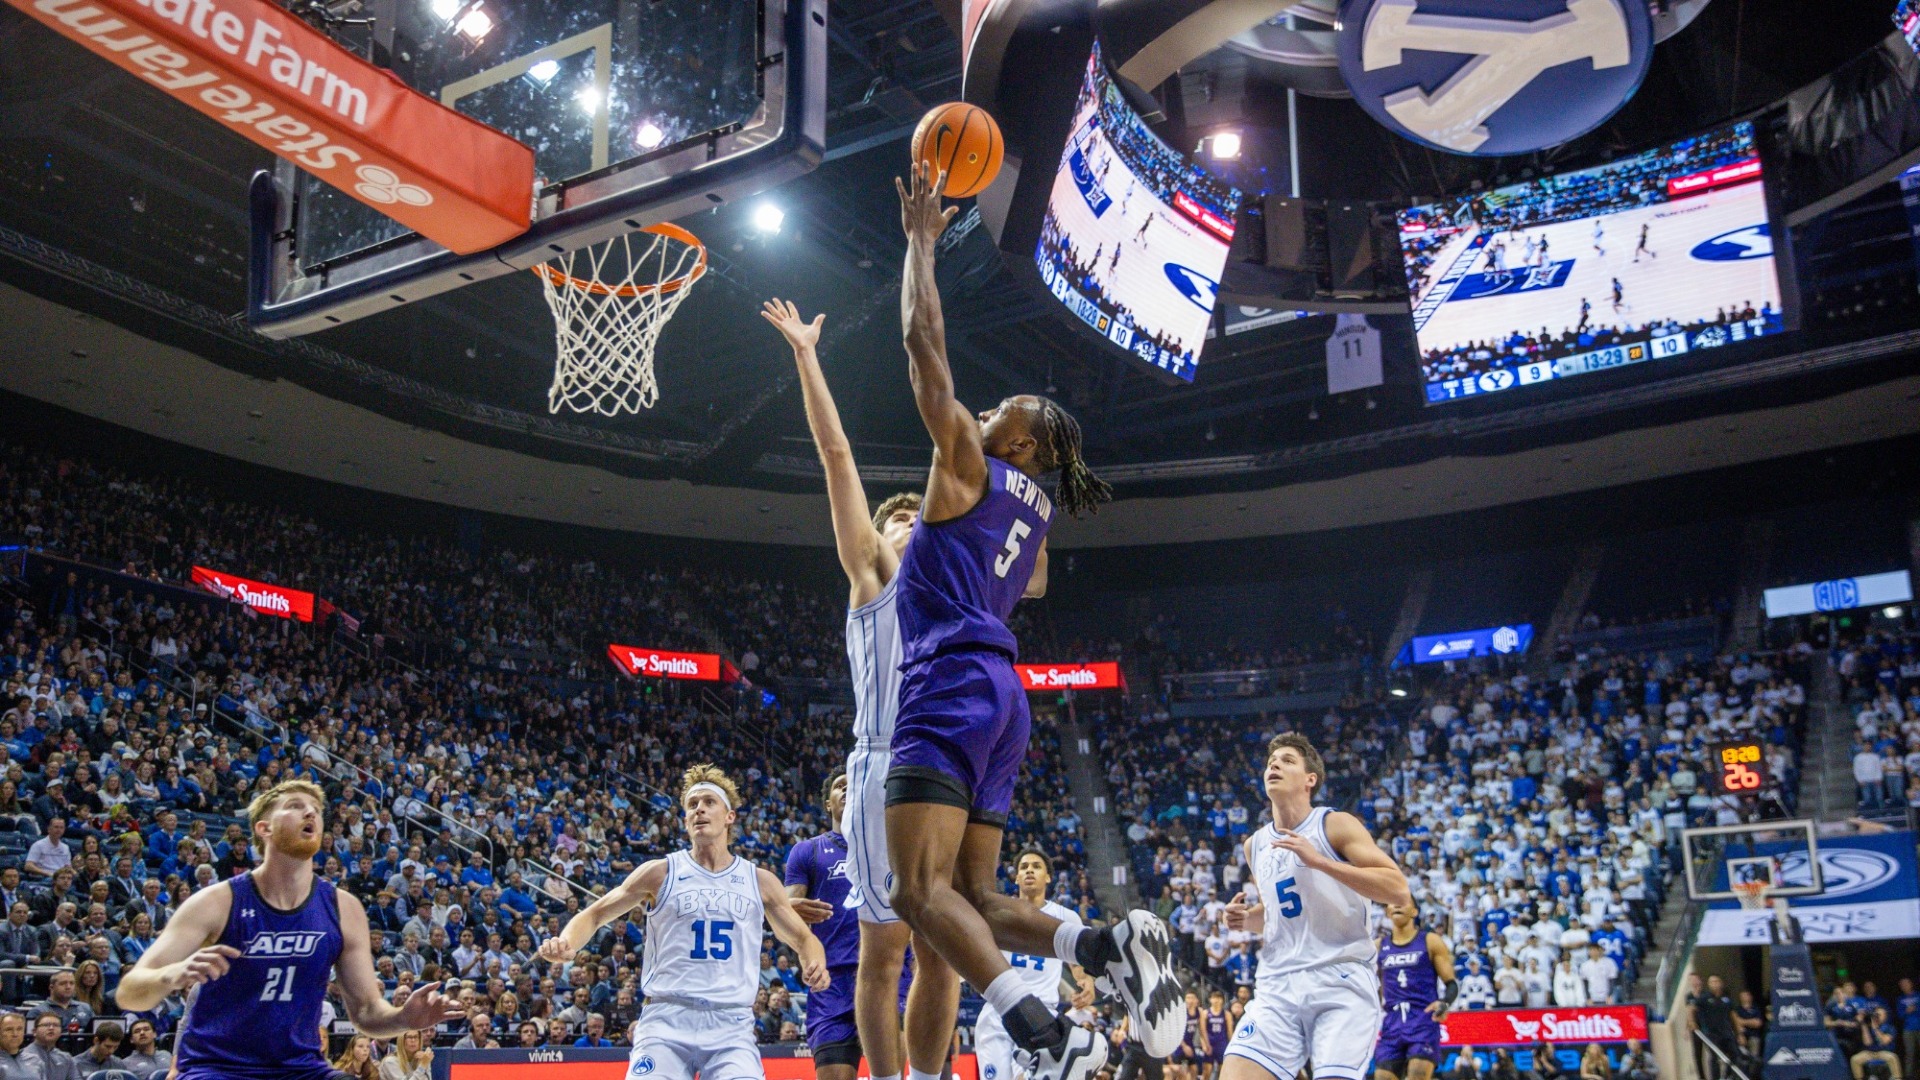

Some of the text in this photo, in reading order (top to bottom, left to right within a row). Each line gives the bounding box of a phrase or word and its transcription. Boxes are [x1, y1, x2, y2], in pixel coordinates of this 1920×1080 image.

[1057, 279, 1063, 295] 9
[1077, 298, 1098, 326] 13:29
[1116, 326, 1127, 345] 10
[1661, 338, 1678, 354] 10
[1342, 338, 1362, 360] 11
[1583, 348, 1624, 371] 13:29
[1530, 366, 1541, 381] 9
[1005, 469, 1052, 523] NEWTON
[994, 518, 1032, 579] 5
[238, 583, 290, 613] Smith's
[649, 654, 698, 675] Smith's
[1048, 668, 1097, 686] Smith's
[1725, 763, 1760, 790] 26
[677, 888, 750, 920] BYU
[1275, 876, 1303, 919] 5
[690, 918, 735, 960] 15
[1744, 921, 1878, 939] BNK
[246, 932, 320, 956] ACU
[1383, 951, 1420, 968] ACU
[259, 965, 297, 1002] 21
[1396, 969, 1408, 988] 4
[1542, 1013, 1623, 1040] Smith's
